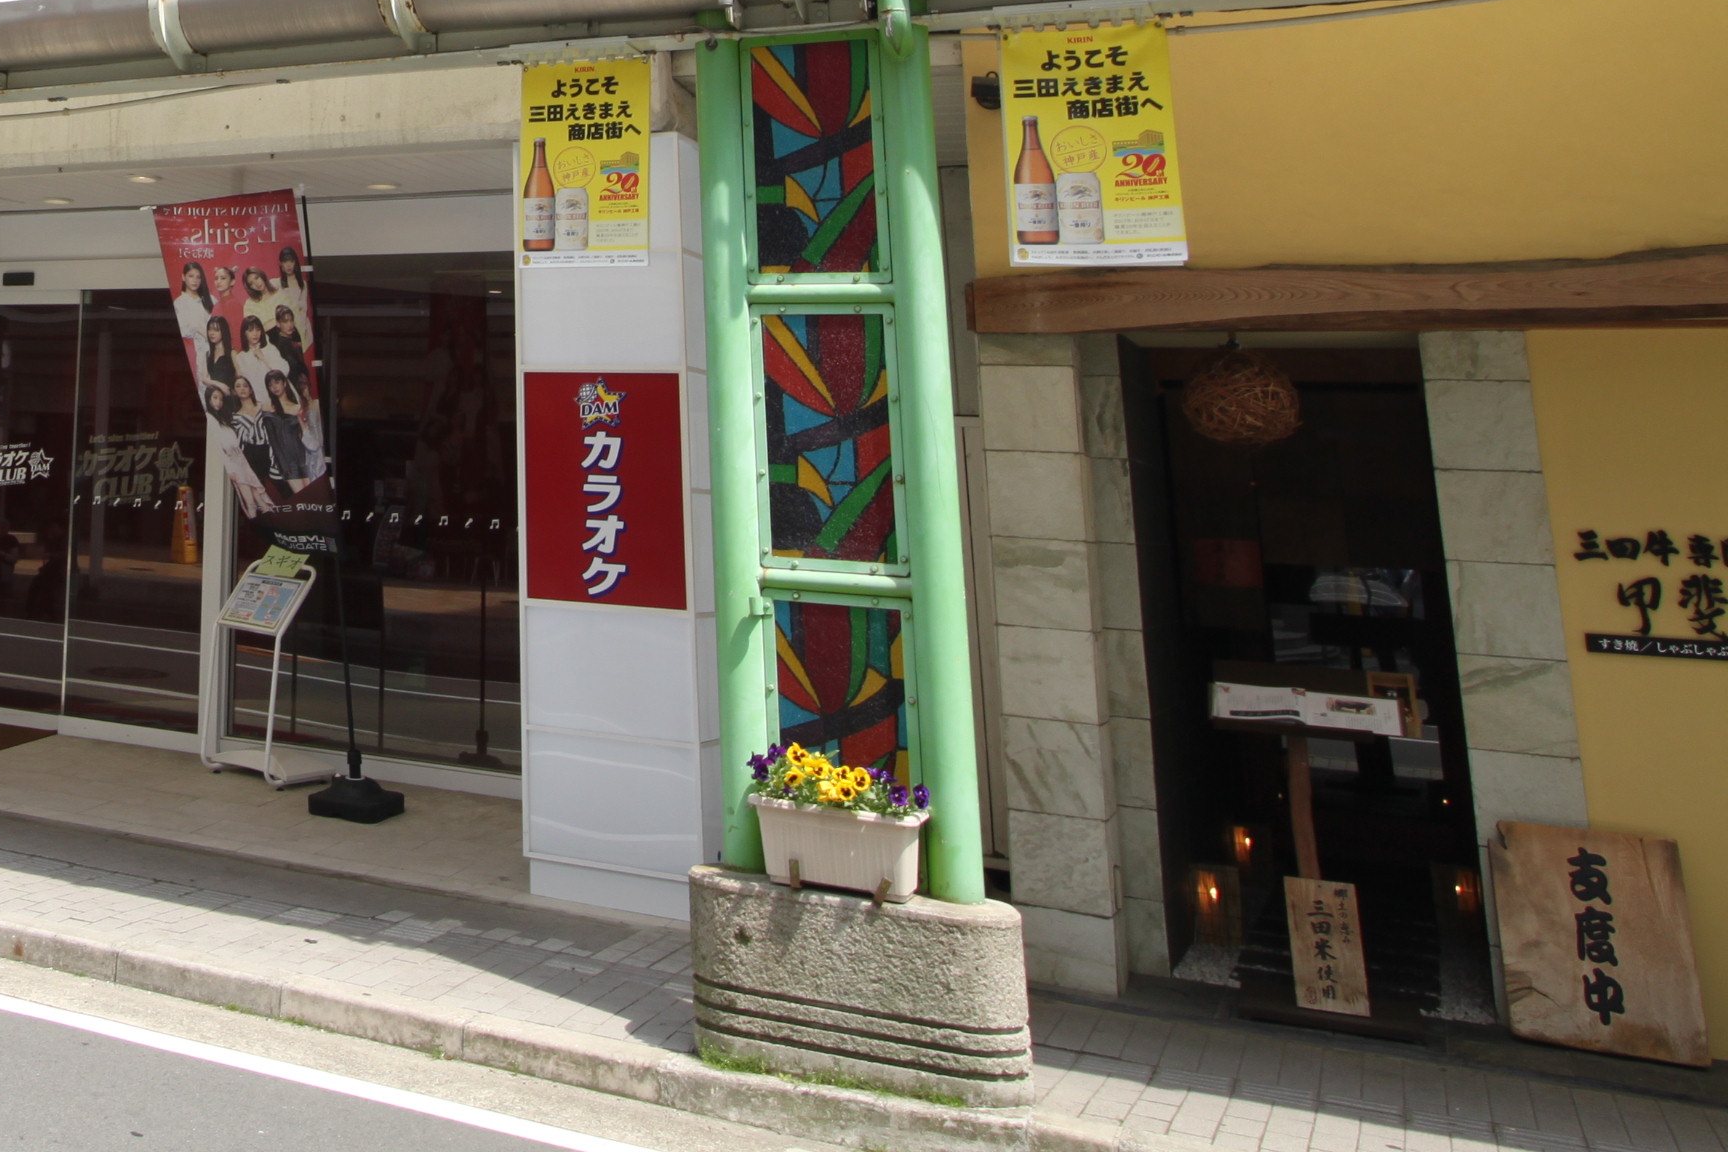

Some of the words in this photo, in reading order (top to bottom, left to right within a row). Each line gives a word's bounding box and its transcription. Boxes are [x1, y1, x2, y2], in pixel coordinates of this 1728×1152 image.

[1067, 35, 1094, 44] KIRIN
[1040, 46, 1129, 72] ようこそ
[550, 76, 619, 99] ようこそ
[1013, 72, 1149, 99] 三田えきまえ
[528, 101, 633, 123] 三田えきまえ
[1067, 96, 1164, 120] 商店街へ
[568, 122, 642, 142] 商店街へ
[1055, 133, 1100, 152] おいしさ
[556, 153, 591, 169] おいしさ
[1062, 150, 1101, 167] 神戸産
[1114, 176, 1168, 188] ANNIVERSARY
[599, 193, 640, 202] ANNIVERSARY
[579, 399, 620, 420] DAM
[582, 430, 627, 597] カラオケ
[1573, 529, 1728, 569] 三田牛専
[1566, 847, 1625, 1026] 支度中
[1306, 899, 1339, 1000] 三田米使用
